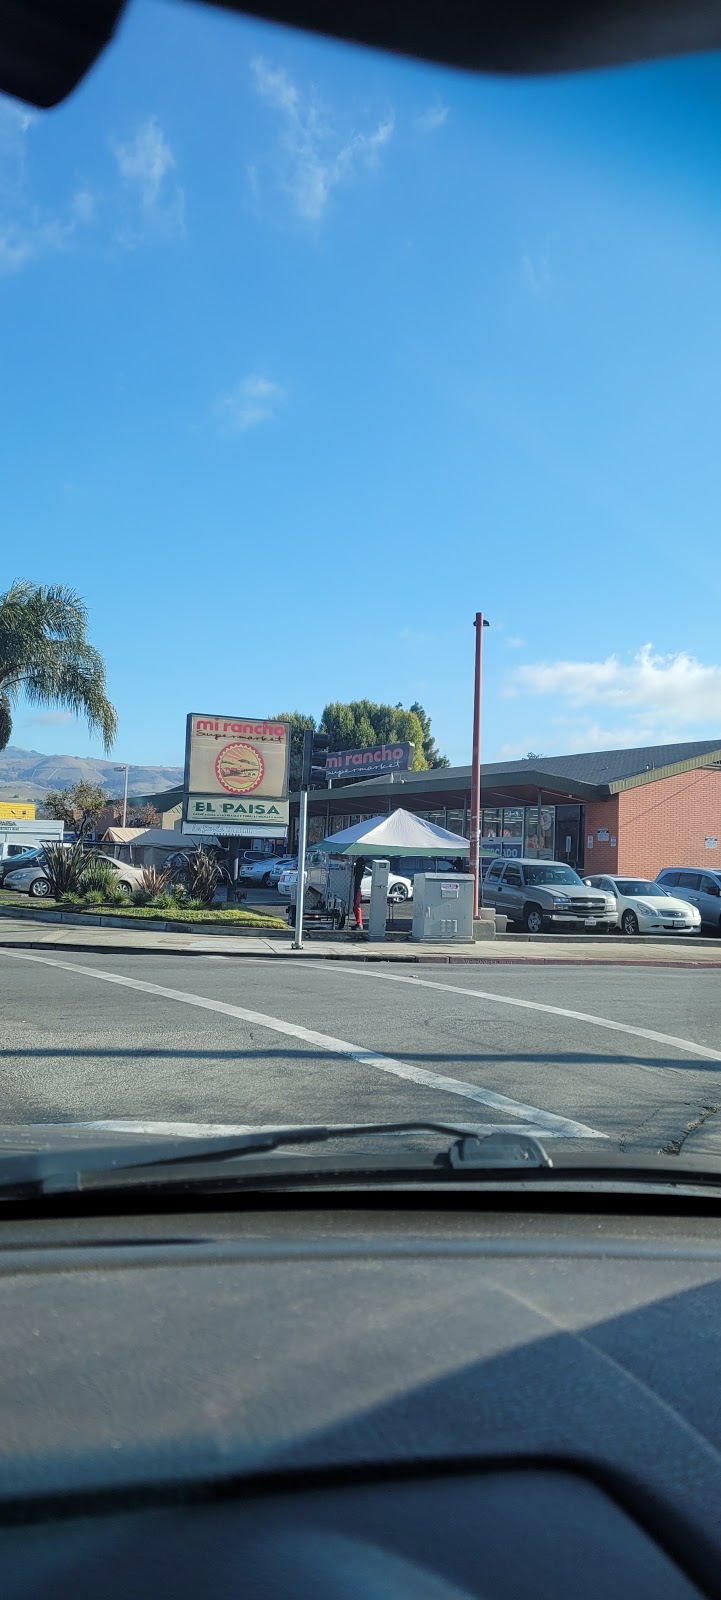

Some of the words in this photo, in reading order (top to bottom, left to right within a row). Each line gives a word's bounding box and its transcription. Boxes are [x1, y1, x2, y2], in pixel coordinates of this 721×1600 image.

[196, 718, 219, 731] mi
[223, 721, 285, 737] rancho
[326, 752, 342, 768] mi
[345, 745, 404, 766] rancho
[195, 802, 216, 813] EL
[222, 803, 280, 815] PAISA
